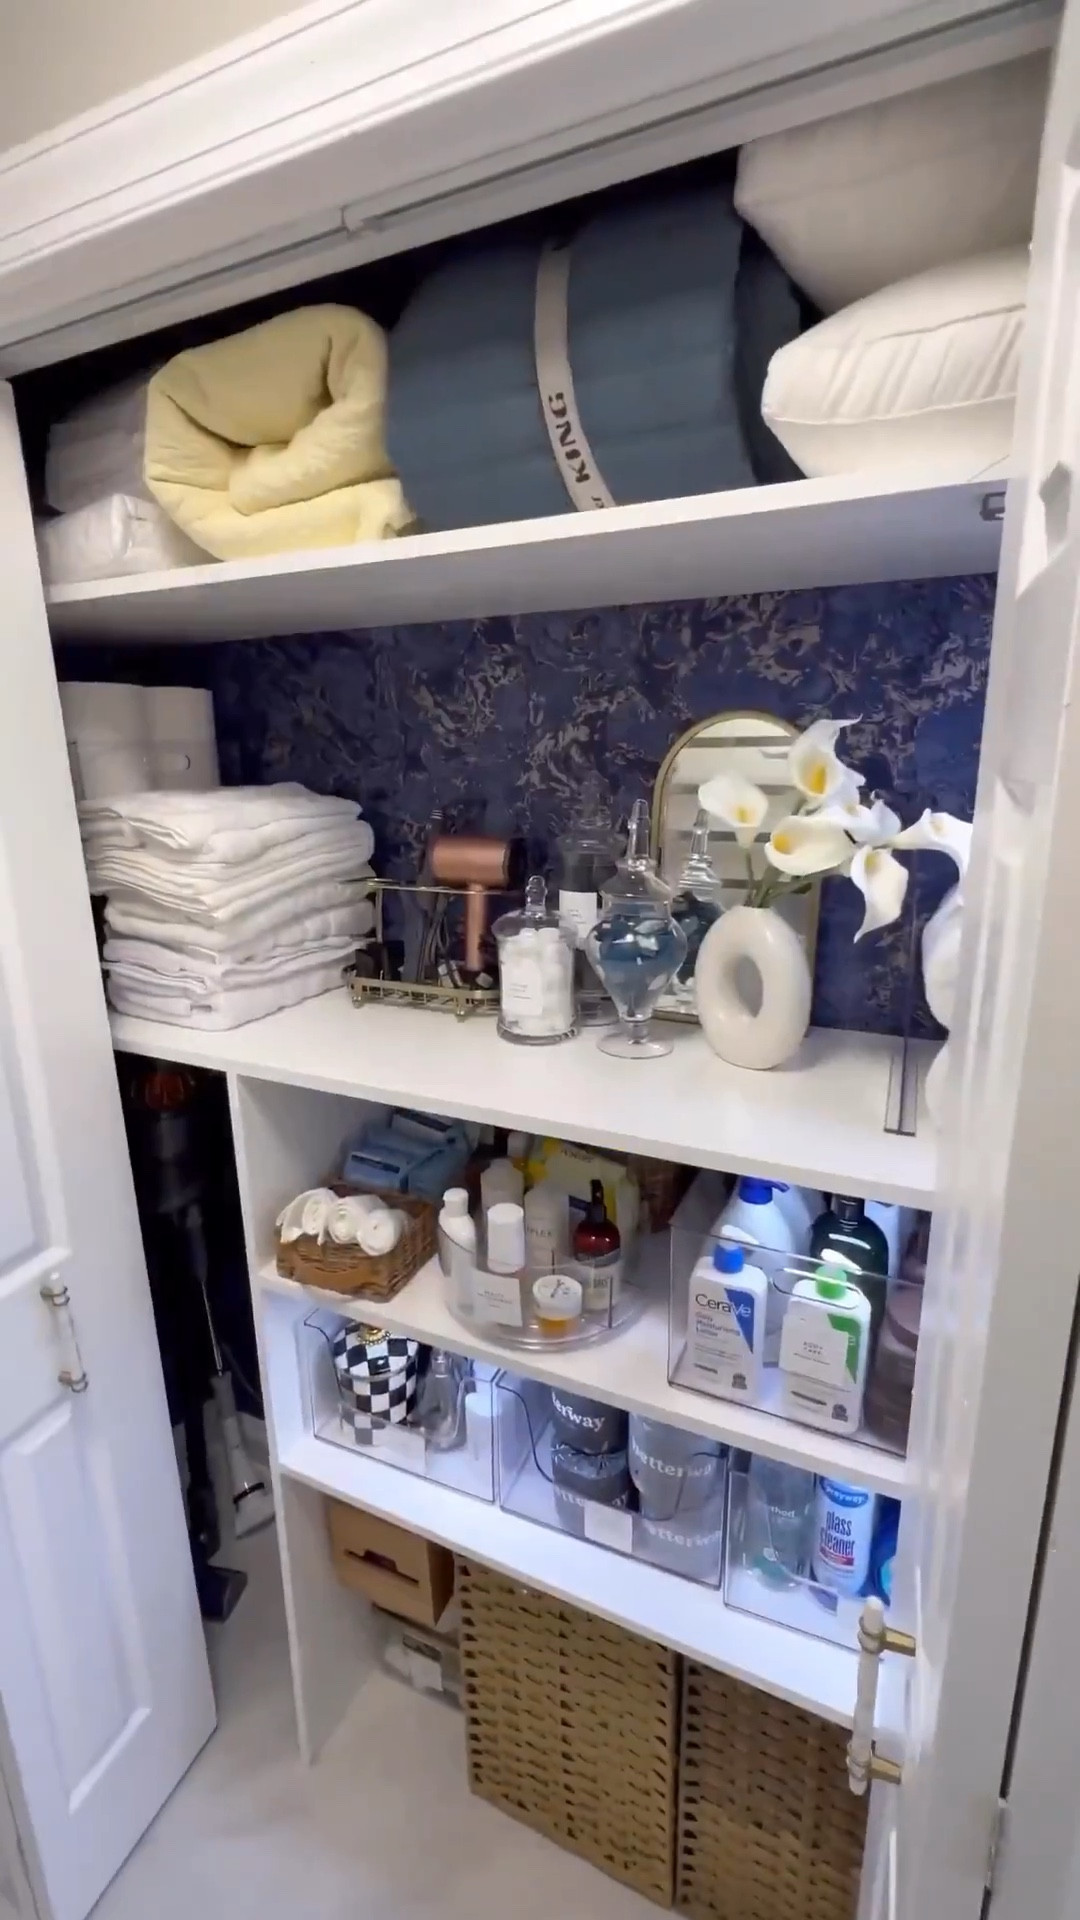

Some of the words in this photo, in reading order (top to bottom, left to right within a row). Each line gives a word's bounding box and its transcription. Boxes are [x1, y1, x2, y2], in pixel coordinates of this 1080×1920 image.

[548, 392, 591, 483] KING
[695, 1293, 751, 1317] CeraVe
[826, 1510, 853, 1537] glass
[820, 1526, 856, 1557] cleaner
